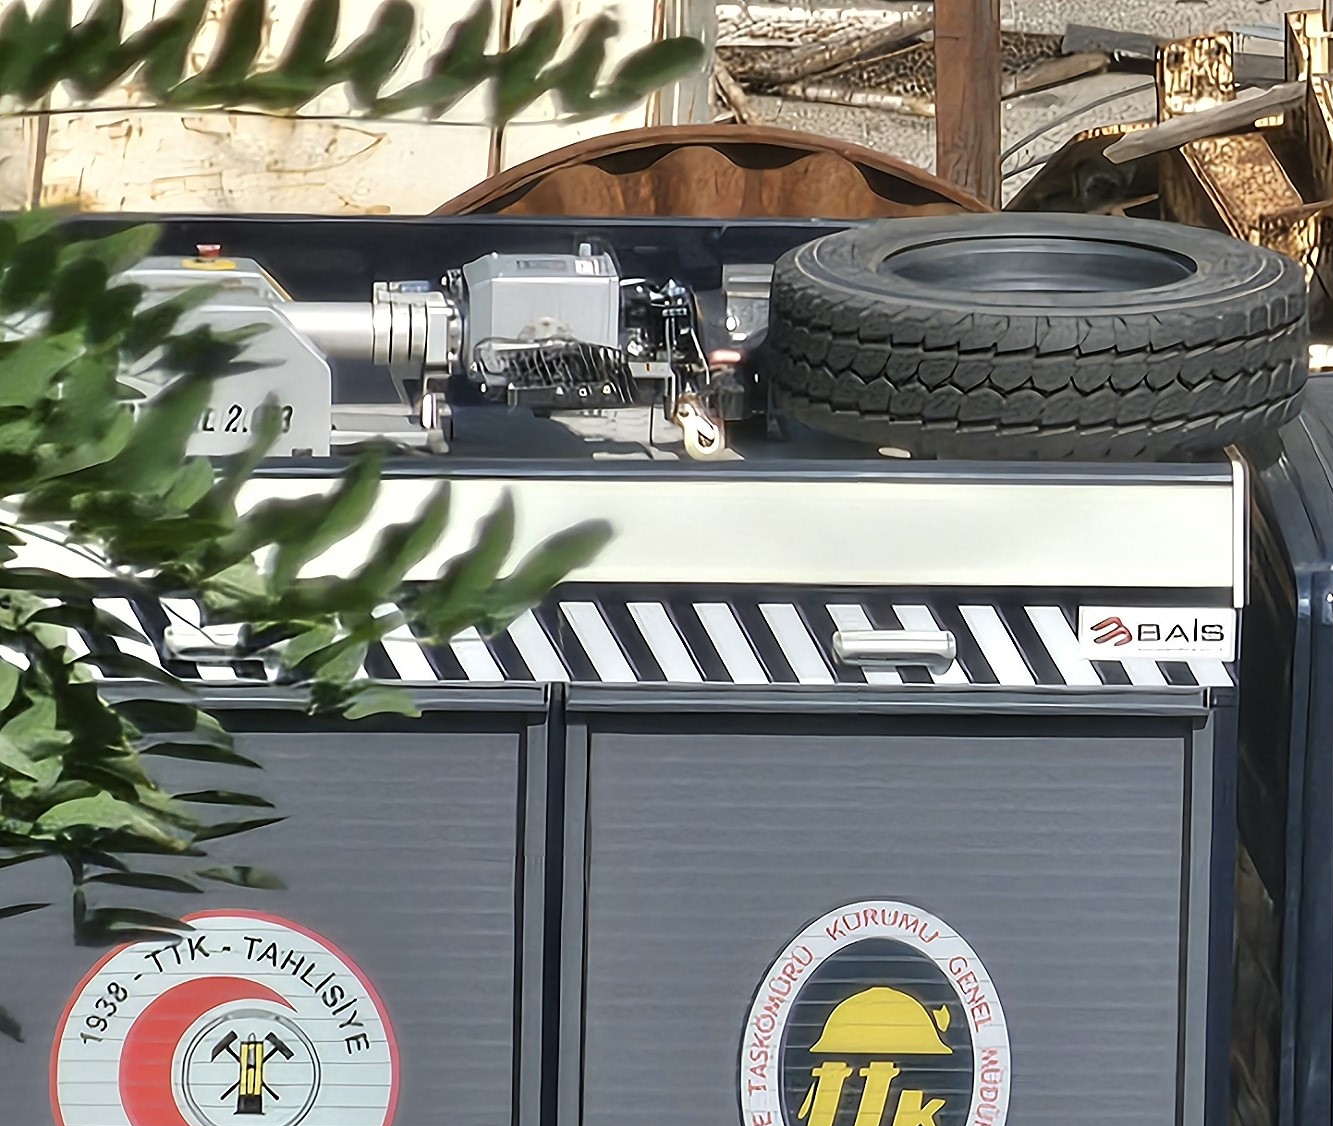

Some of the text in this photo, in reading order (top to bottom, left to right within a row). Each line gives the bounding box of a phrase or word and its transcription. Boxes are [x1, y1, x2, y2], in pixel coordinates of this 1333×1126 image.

[80, 981, 129, 1045] 1938
[145, 935, 210, 973] TTK
[948, 955, 992, 1034] GENEL
